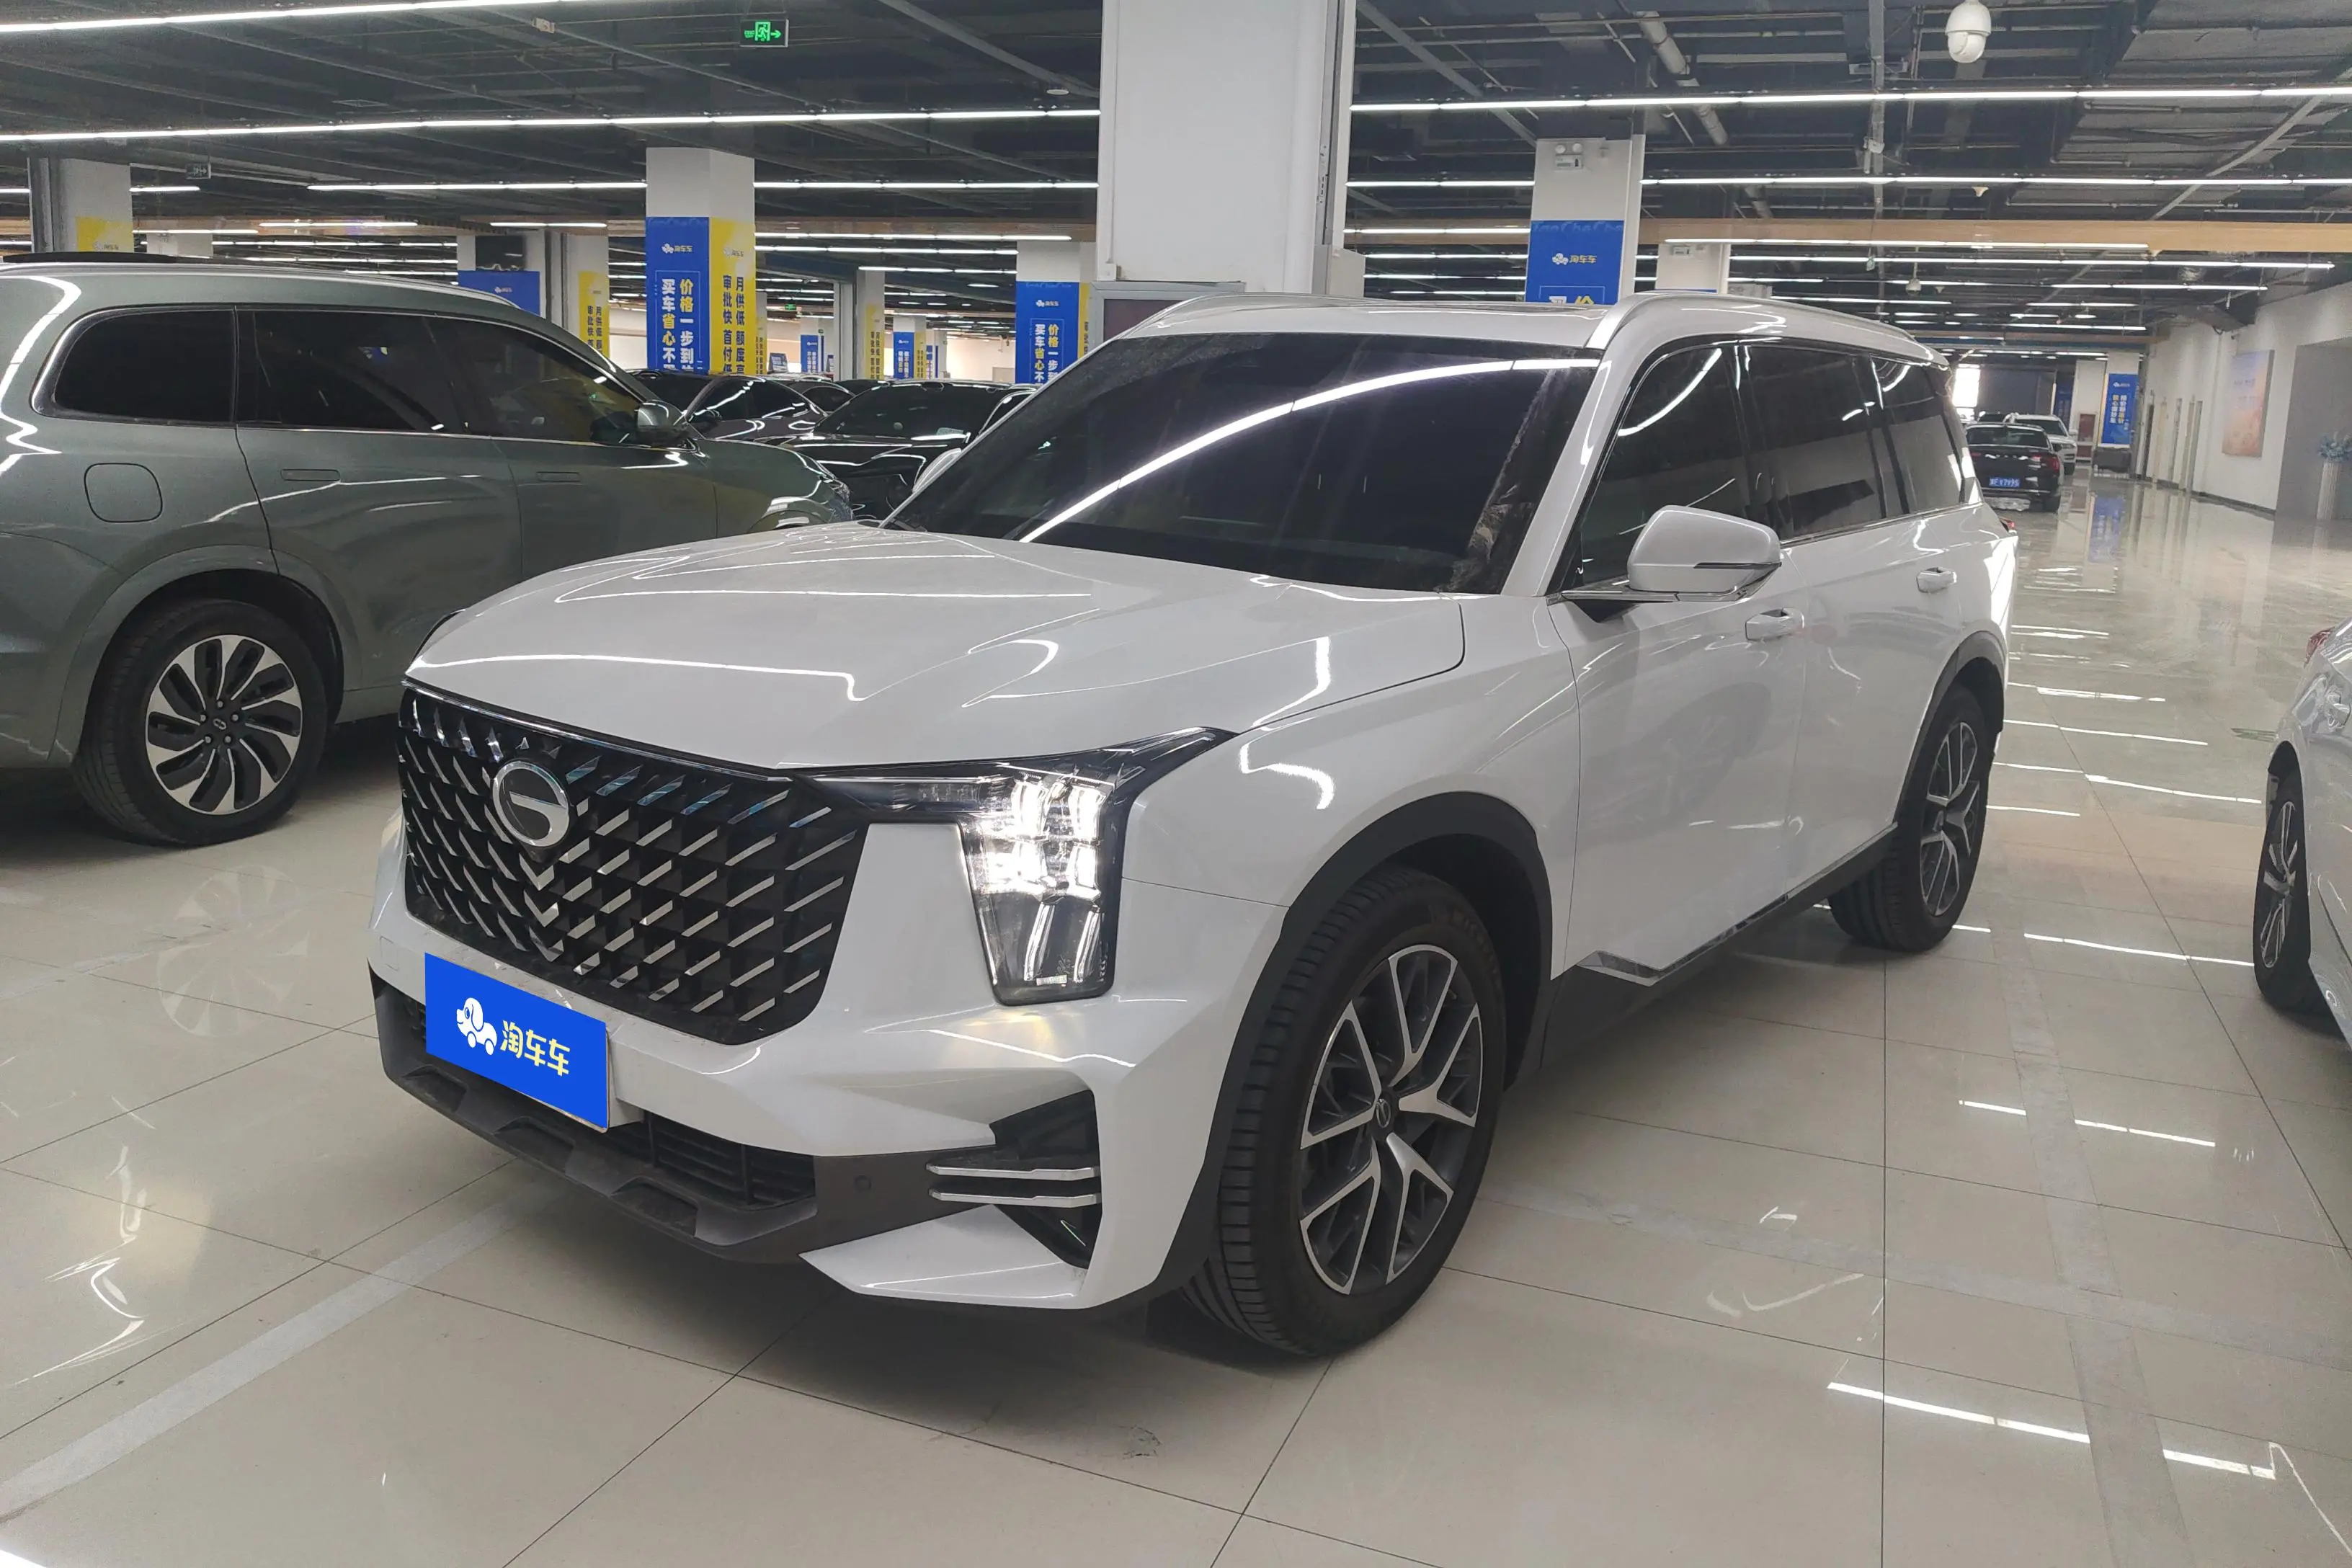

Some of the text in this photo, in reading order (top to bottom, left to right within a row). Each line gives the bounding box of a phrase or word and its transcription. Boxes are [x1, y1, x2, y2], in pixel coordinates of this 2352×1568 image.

[723, 275, 732, 324] 审批快
[736, 277, 745, 326] 月供低
[1034, 324, 1046, 386] 买车省心不
